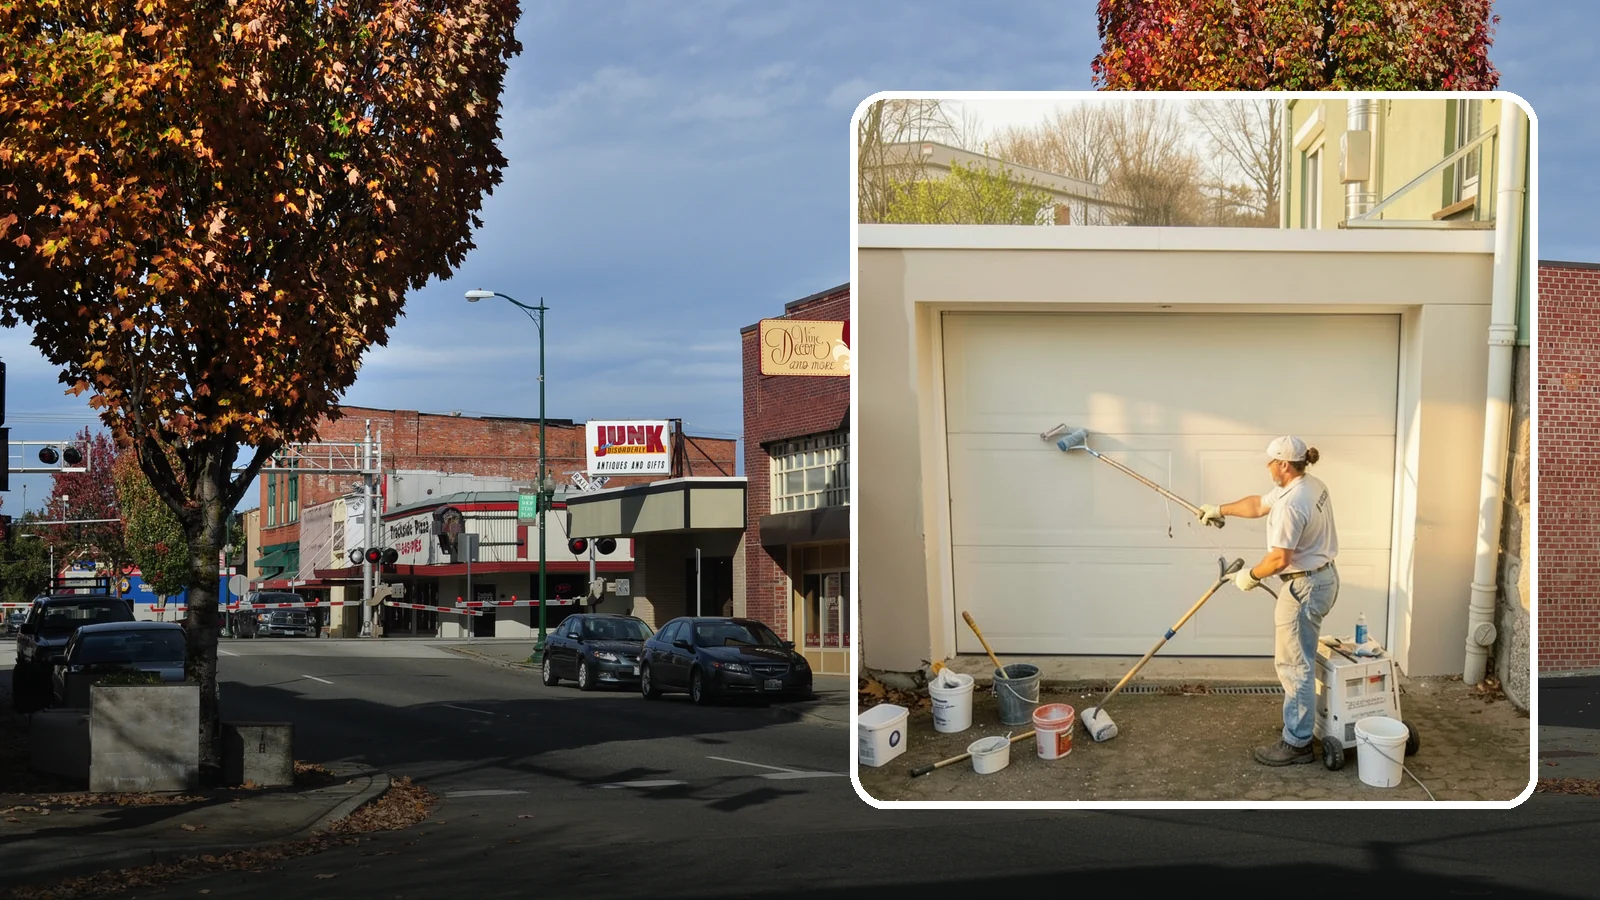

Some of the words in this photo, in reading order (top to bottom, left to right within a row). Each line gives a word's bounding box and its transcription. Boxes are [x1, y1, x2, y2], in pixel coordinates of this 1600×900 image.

[595, 425, 665, 457] JUNK
[607, 446, 645, 454] DISORDERLY
[597, 461, 628, 470] ANTIQUES
[631, 461, 643, 470] AND
[647, 460, 665, 469] GIFTS
[573, 473, 589, 492] RAIL
[390, 522, 413, 540] Trackside
[414, 519, 429, 534] Pizza
